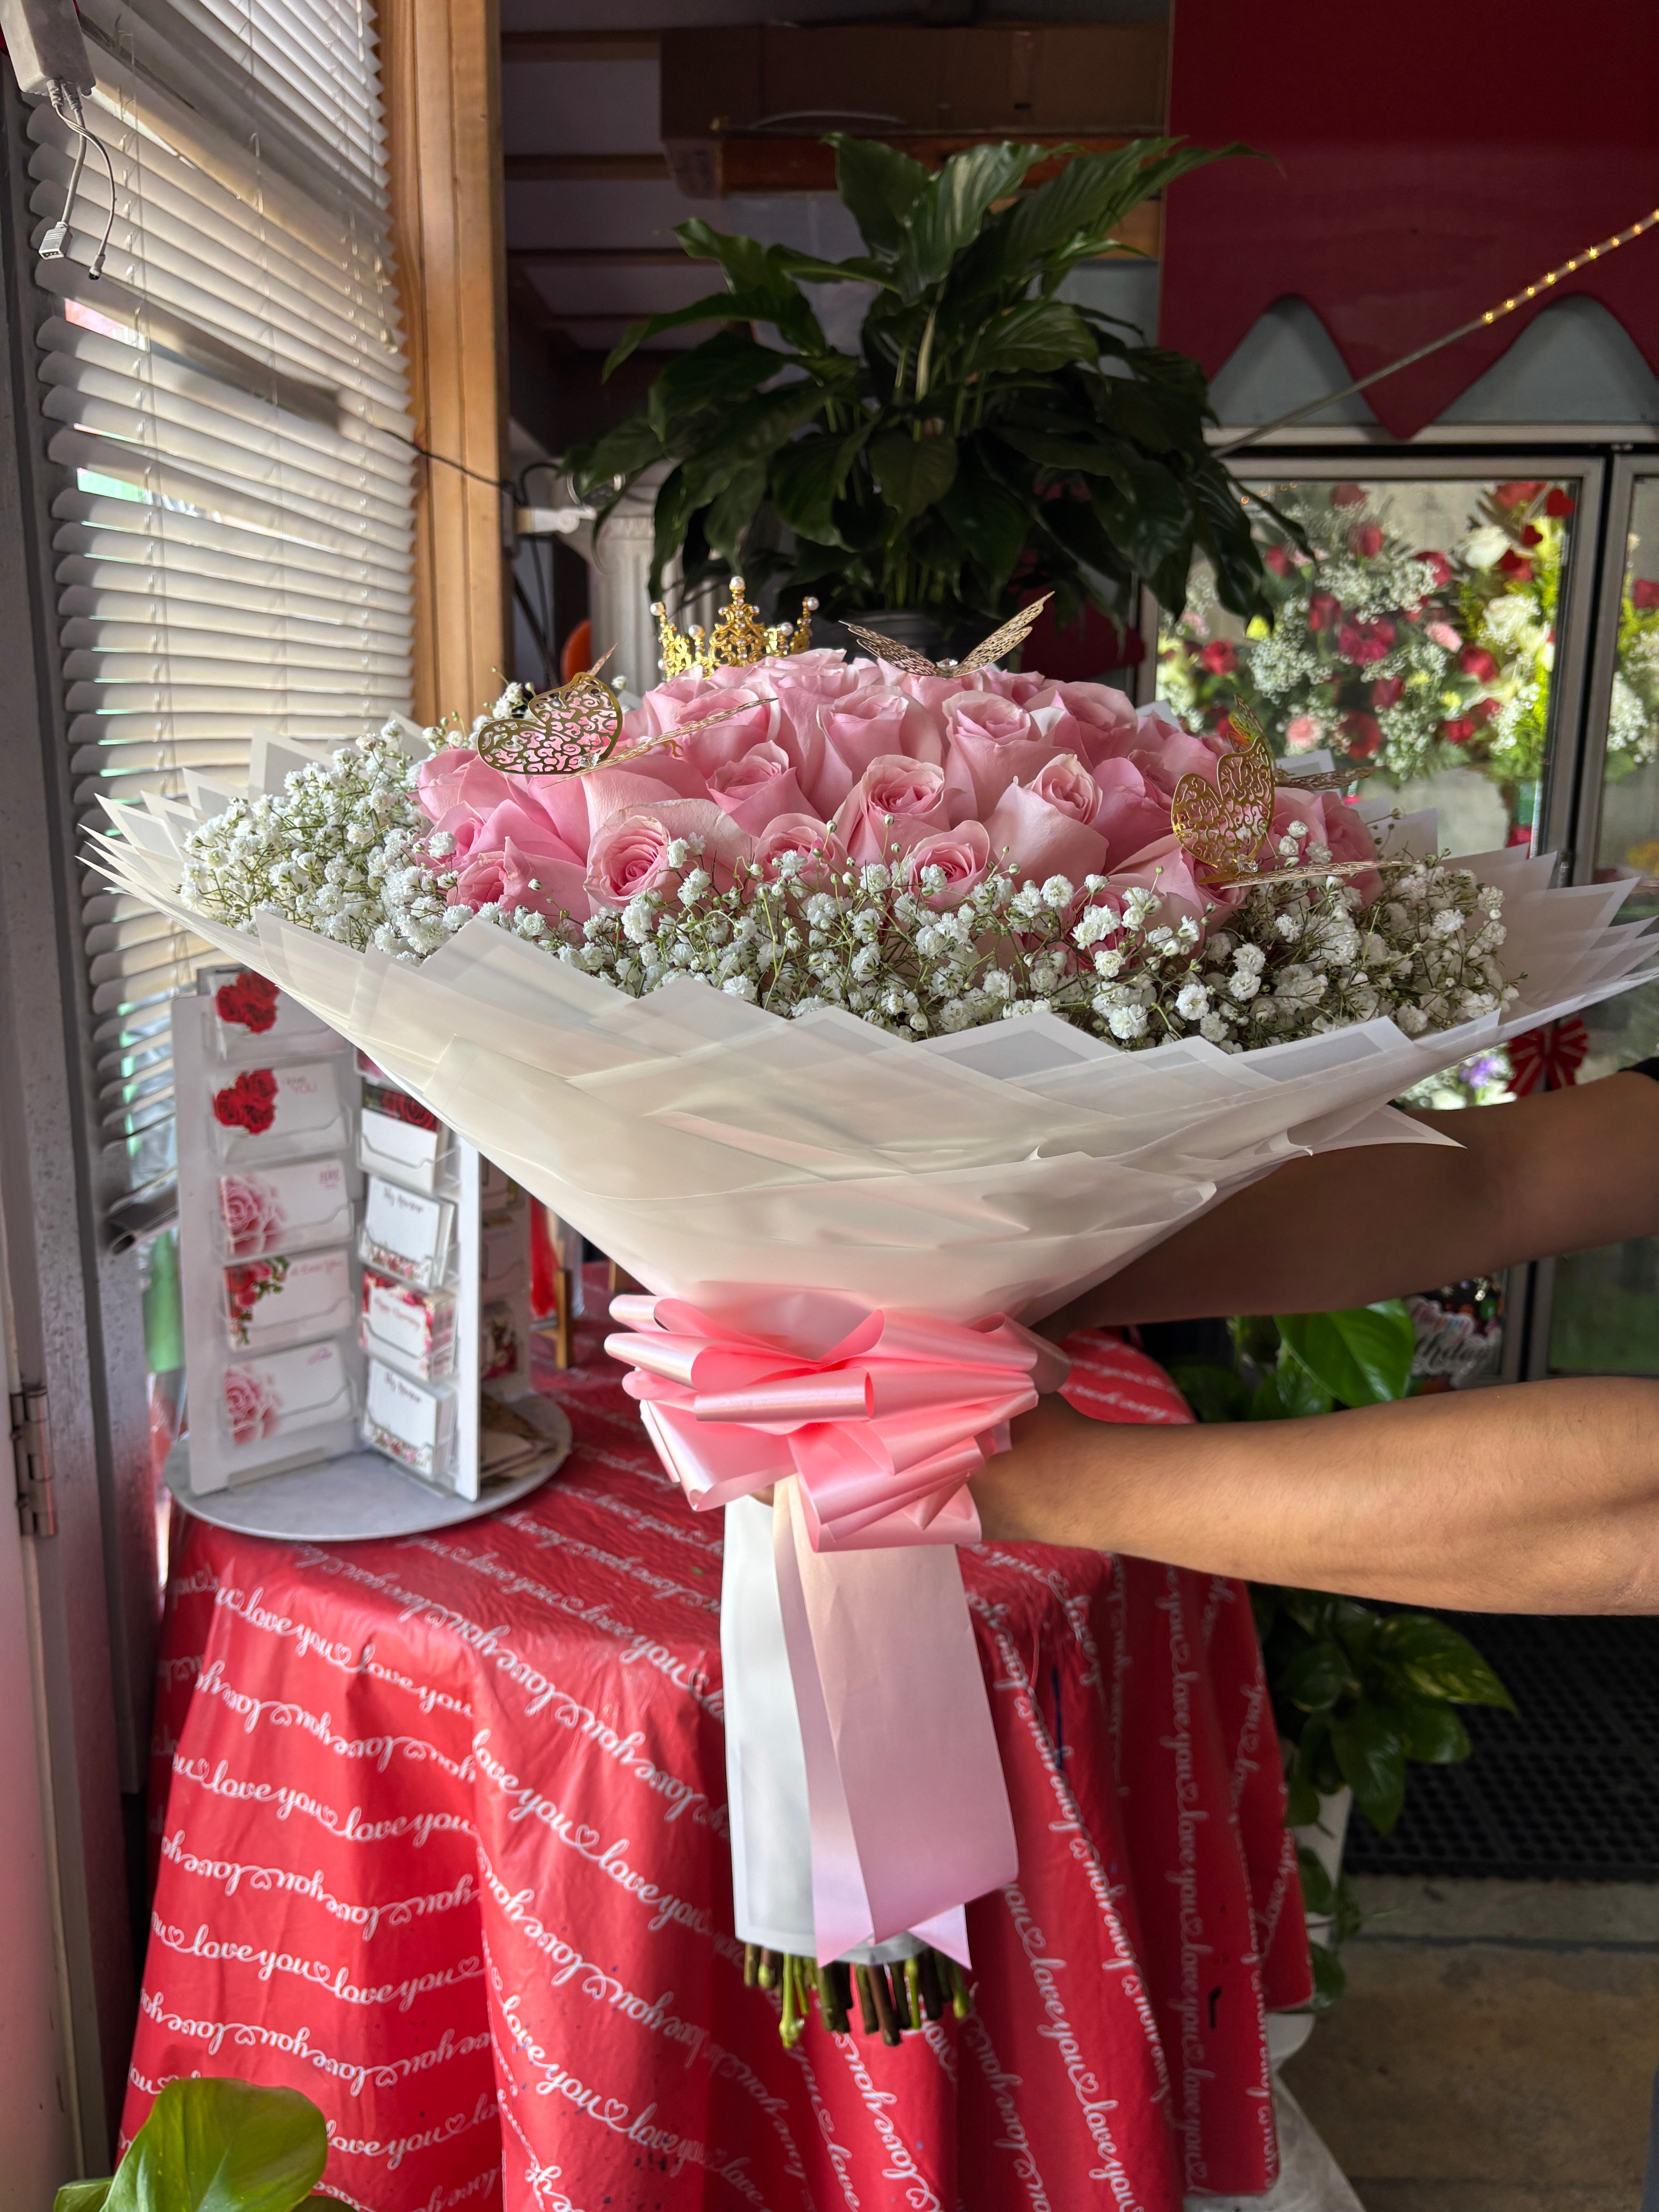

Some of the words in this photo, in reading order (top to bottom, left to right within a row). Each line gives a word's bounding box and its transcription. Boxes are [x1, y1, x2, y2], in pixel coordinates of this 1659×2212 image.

[496, 1649, 556, 1716] love
[240, 1587, 293, 1637] love
[415, 1685, 475, 1719] you
[508, 1788, 573, 1839] you
[599, 1839, 658, 1905] love
[333, 1735, 393, 1772] love
[583, 1706, 646, 1764] you
[211, 1760, 274, 1801] love
[275, 1787, 322, 1820] you
[346, 1806, 407, 1841] love
[406, 1813, 469, 1847] you
[184, 1859, 242, 1896] love
[276, 1870, 326, 1902] you
[325, 1894, 380, 1941] love
[192, 1924, 258, 1961] love
[258, 1949, 310, 1980] you
[334, 1967, 396, 2004] love
[525, 1919, 583, 1986] love
[1030, 1958, 1066, 2023] love
[167, 2015, 226, 2056] love
[261, 2027, 313, 2059] you
[1036, 2021, 1086, 2078] you
[312, 2051, 366, 2097] love
[536, 2065, 601, 2112] you
[1083, 2100, 1118, 2161] love
